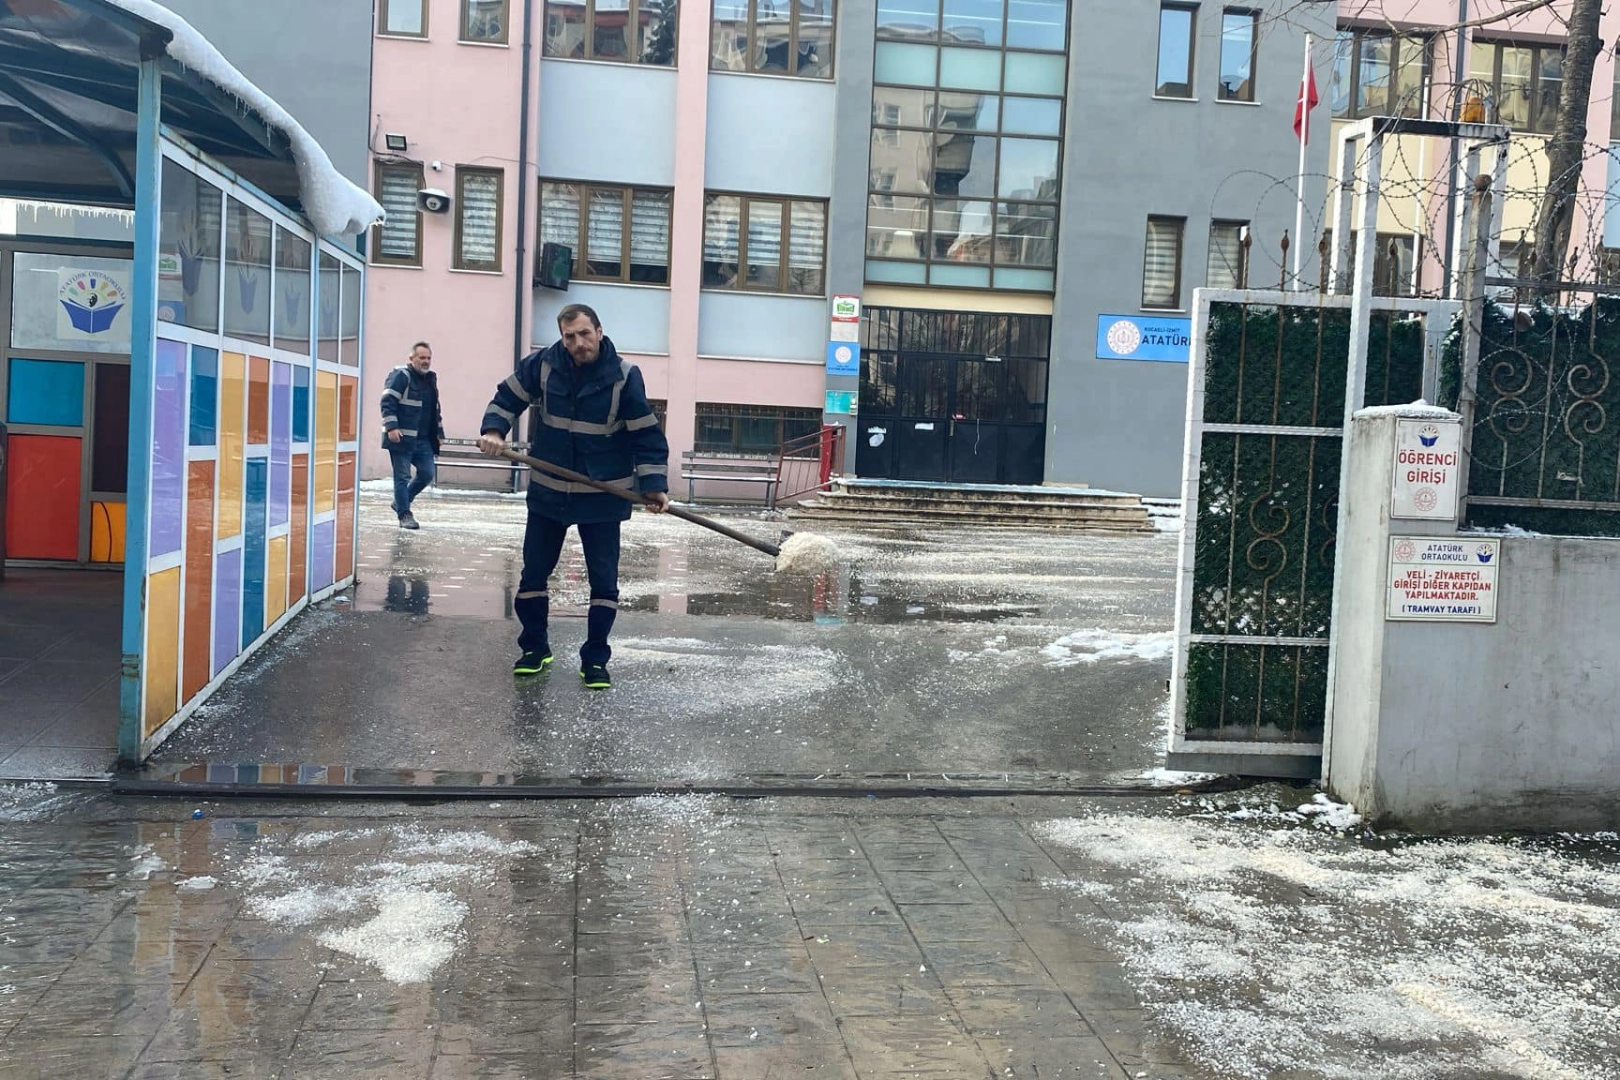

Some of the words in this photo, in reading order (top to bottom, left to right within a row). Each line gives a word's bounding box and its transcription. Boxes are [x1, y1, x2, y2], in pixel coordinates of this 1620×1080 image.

[1398, 449, 1457, 466] ÖĞRENCİ
[1407, 468, 1446, 485] GİRİŞİ
[1427, 544, 1463, 553] ATATÜRK
[1421, 552, 1468, 561] ORTAOKULU
[1406, 570, 1426, 579] VELİ
[1435, 570, 1480, 581] ZİYARETÇİ
[1394, 579, 1420, 590] GİRİŞİ
[1423, 580, 1449, 590] DİĞER
[1452, 581, 1491, 591] KAPIDAN
[1405, 591, 1479, 600] YAPILMAKTADIR.
[1407, 605, 1445, 613] TRAMVAY
[1447, 606, 1476, 614] TARAFI
